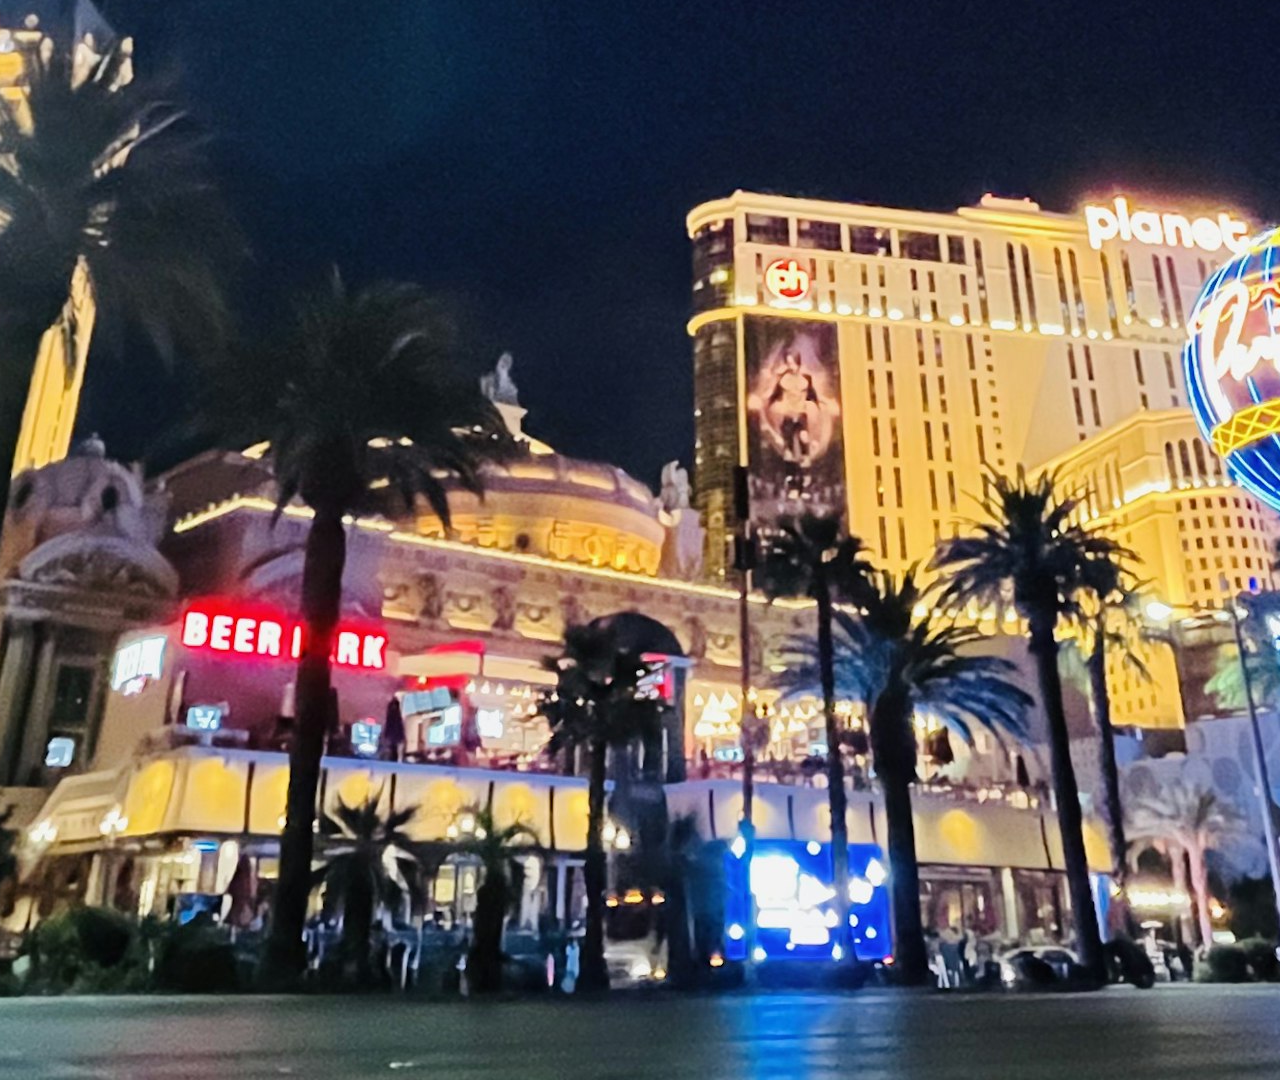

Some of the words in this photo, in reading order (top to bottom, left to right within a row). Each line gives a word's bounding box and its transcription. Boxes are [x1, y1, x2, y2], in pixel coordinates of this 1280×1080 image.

[1084, 196, 1253, 255] planet
[182, 611, 282, 657] BEER
[290, 625, 386, 669] RK
